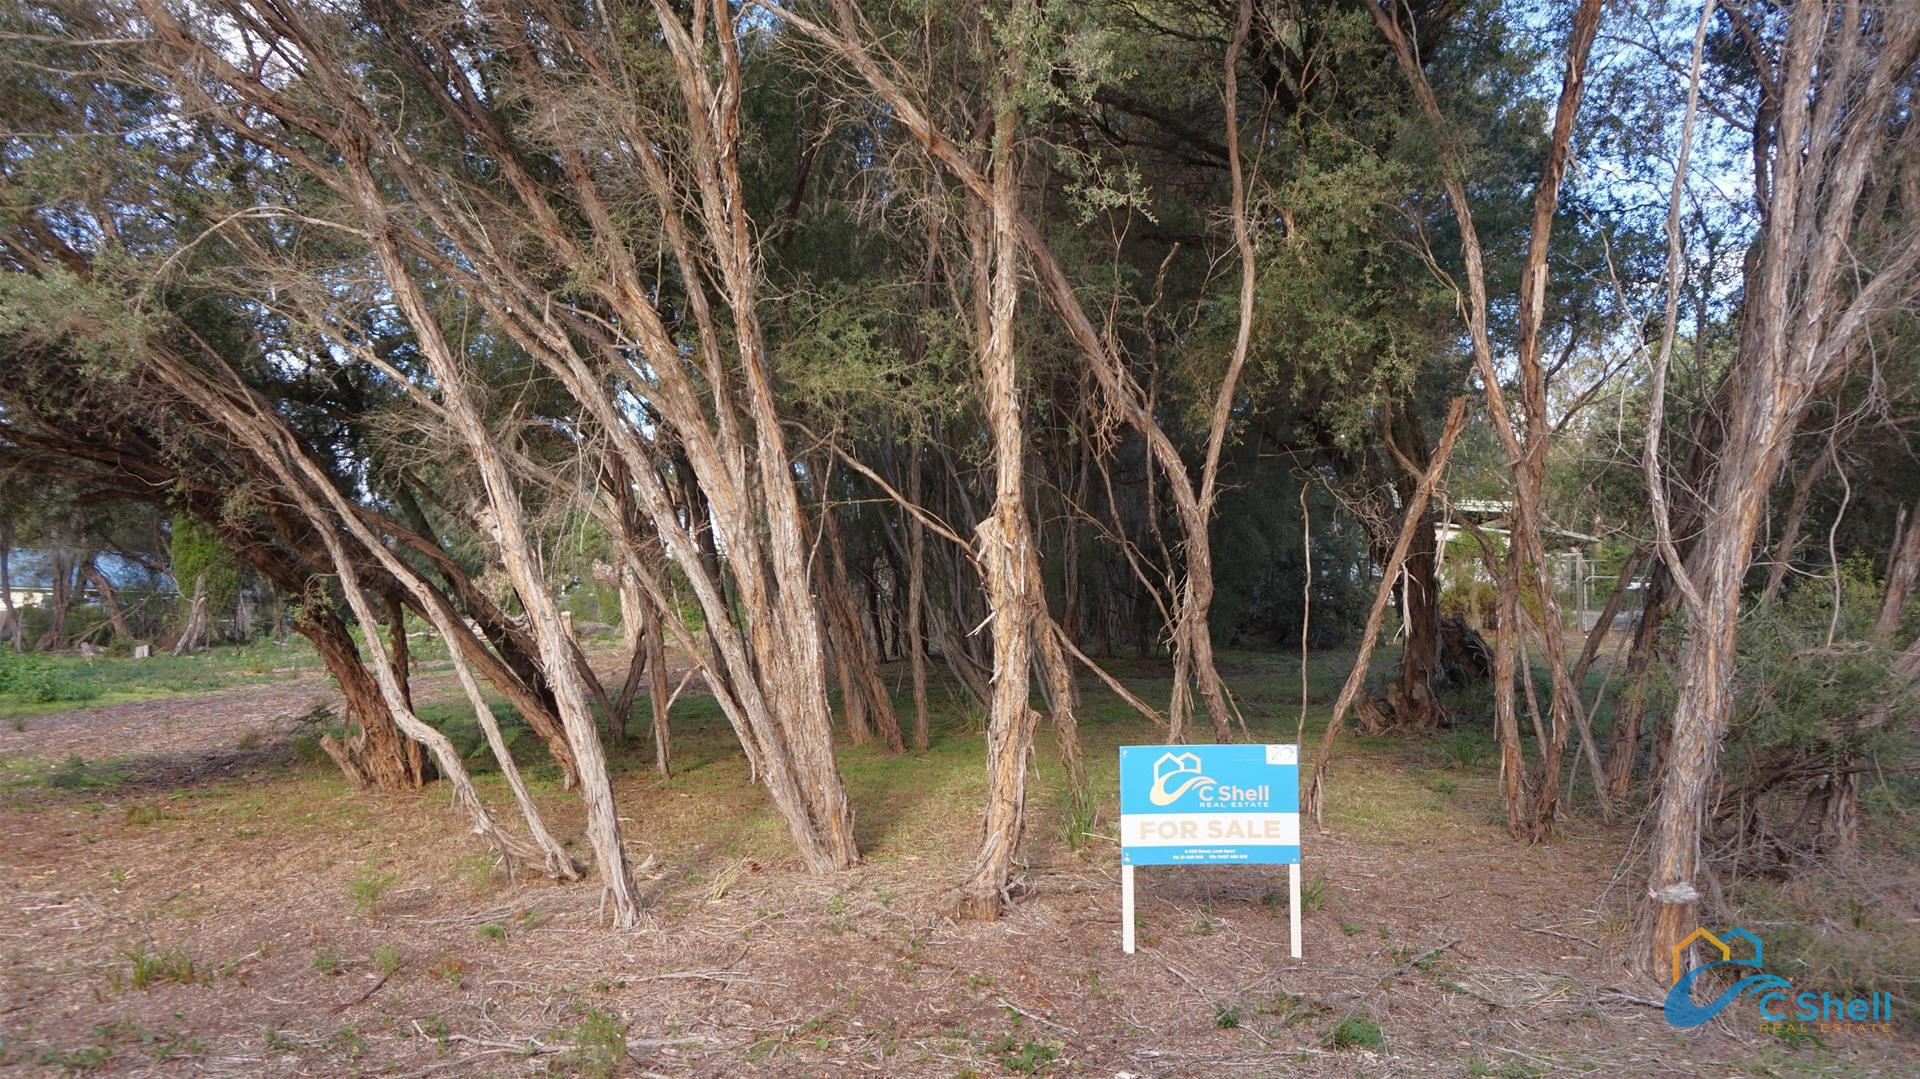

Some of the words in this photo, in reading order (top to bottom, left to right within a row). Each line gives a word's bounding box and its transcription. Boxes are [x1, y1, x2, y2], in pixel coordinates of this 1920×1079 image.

[1199, 786, 1214, 801] C
[1218, 785, 1270, 801] Shell
[1140, 821, 1198, 839] FOR
[1207, 820, 1281, 839] SALE
